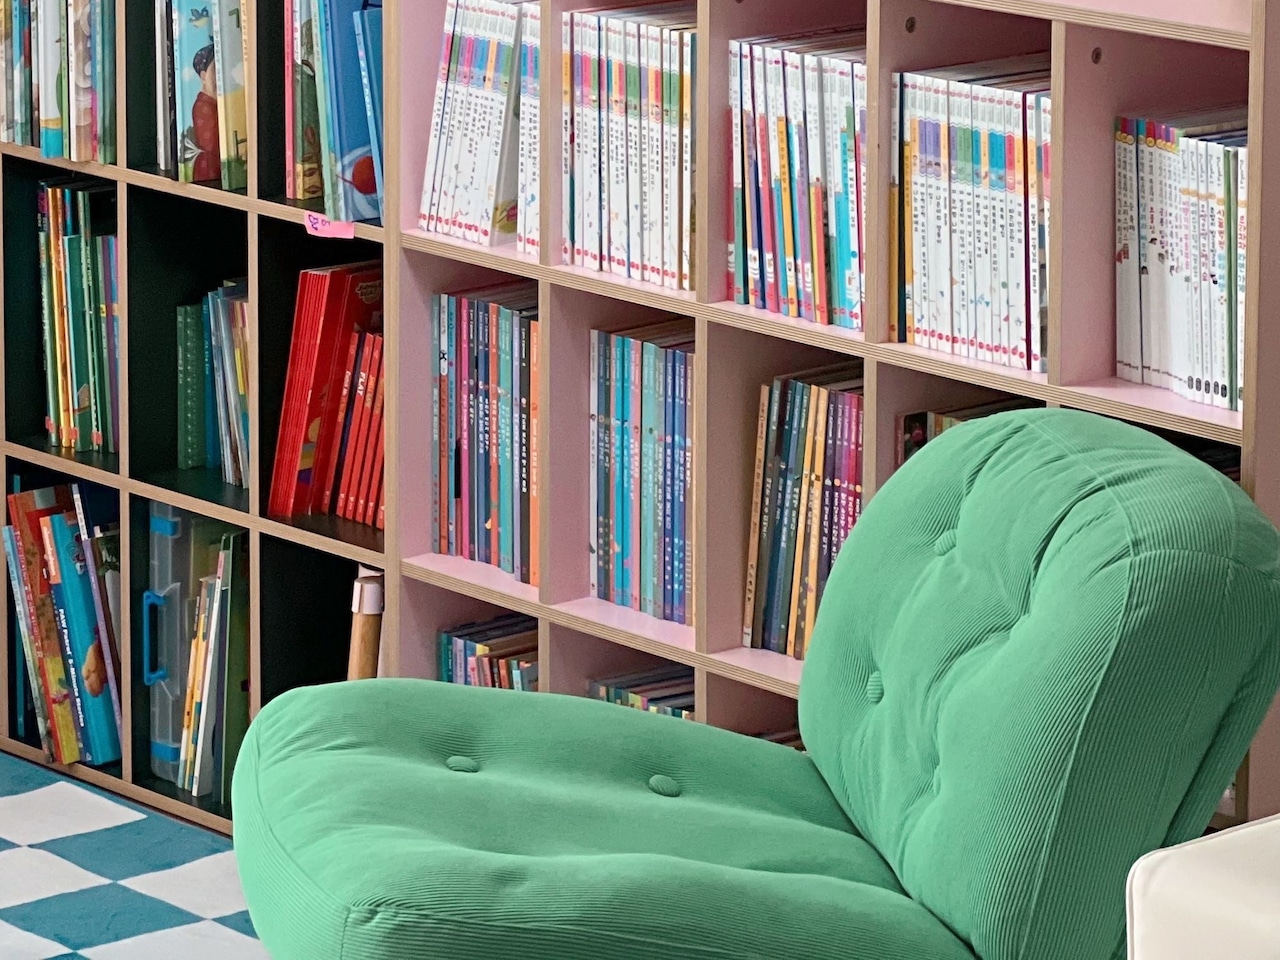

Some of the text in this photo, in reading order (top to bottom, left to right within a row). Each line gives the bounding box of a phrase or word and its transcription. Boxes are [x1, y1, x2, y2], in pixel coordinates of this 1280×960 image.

[58, 608, 66, 628] PAW
[62, 628, 72, 654] Patrol
[75, 697, 86, 726] Stories
